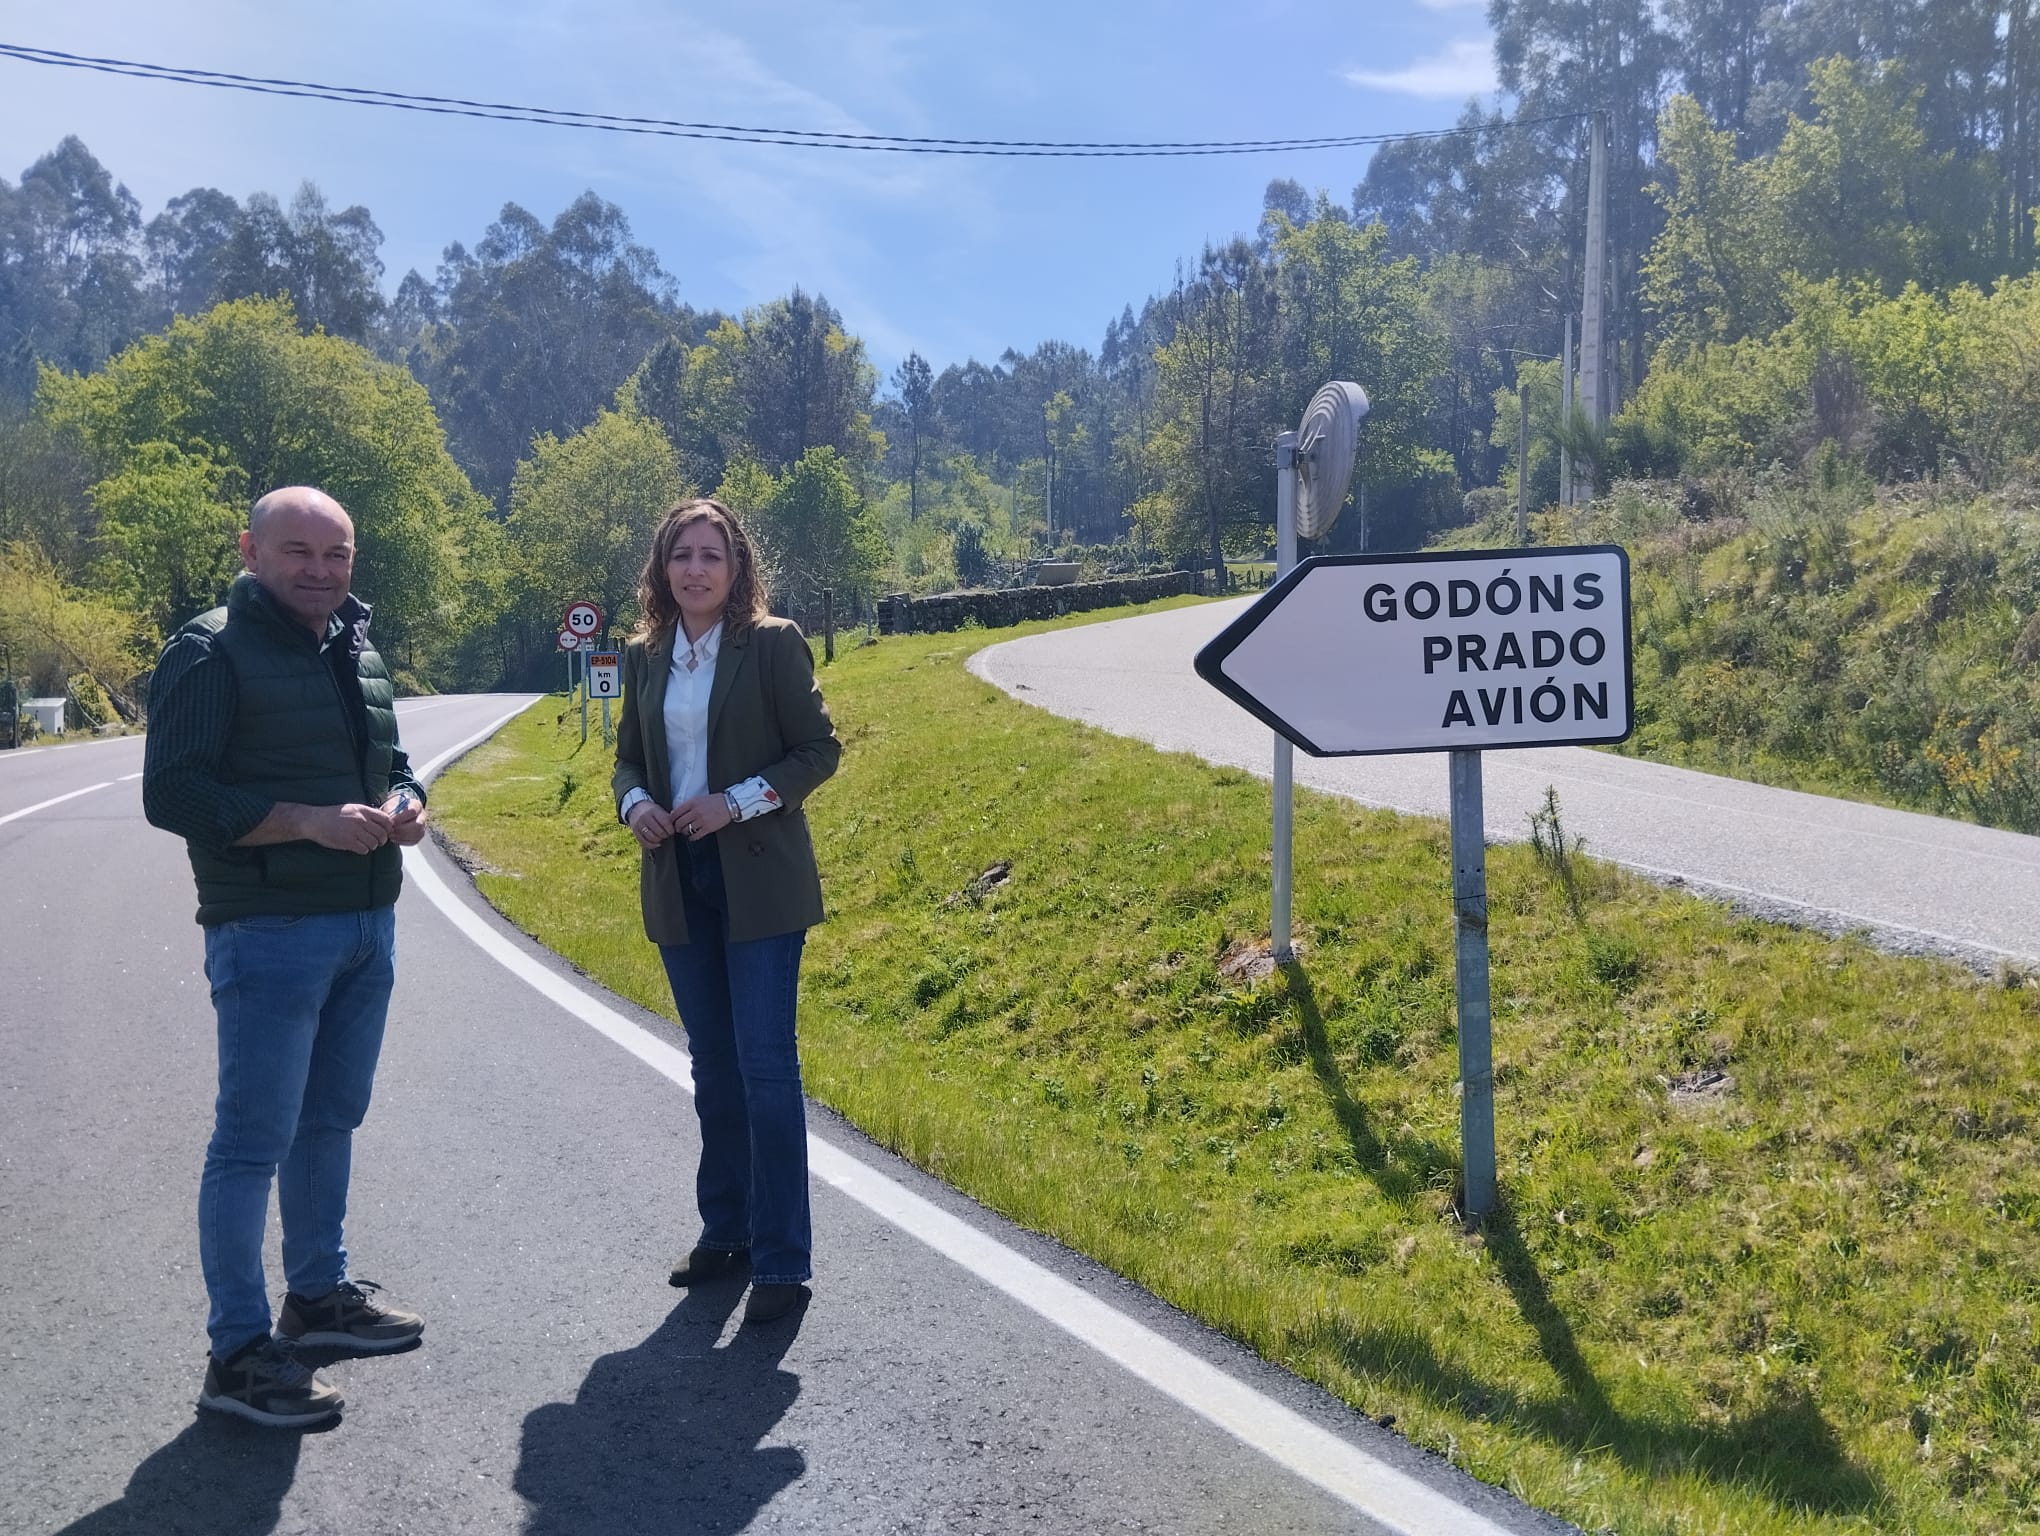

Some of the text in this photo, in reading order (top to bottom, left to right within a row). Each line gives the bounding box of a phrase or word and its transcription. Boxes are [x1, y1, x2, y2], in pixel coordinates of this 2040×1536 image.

[1363, 569, 1604, 622] GODÓNS
[572, 614, 594, 626] 50
[591, 656, 616, 665] EP-5104
[1423, 627, 1605, 674] PRADO
[600, 681, 610, 693] 0
[1442, 677, 1609, 728] AVIÓN
